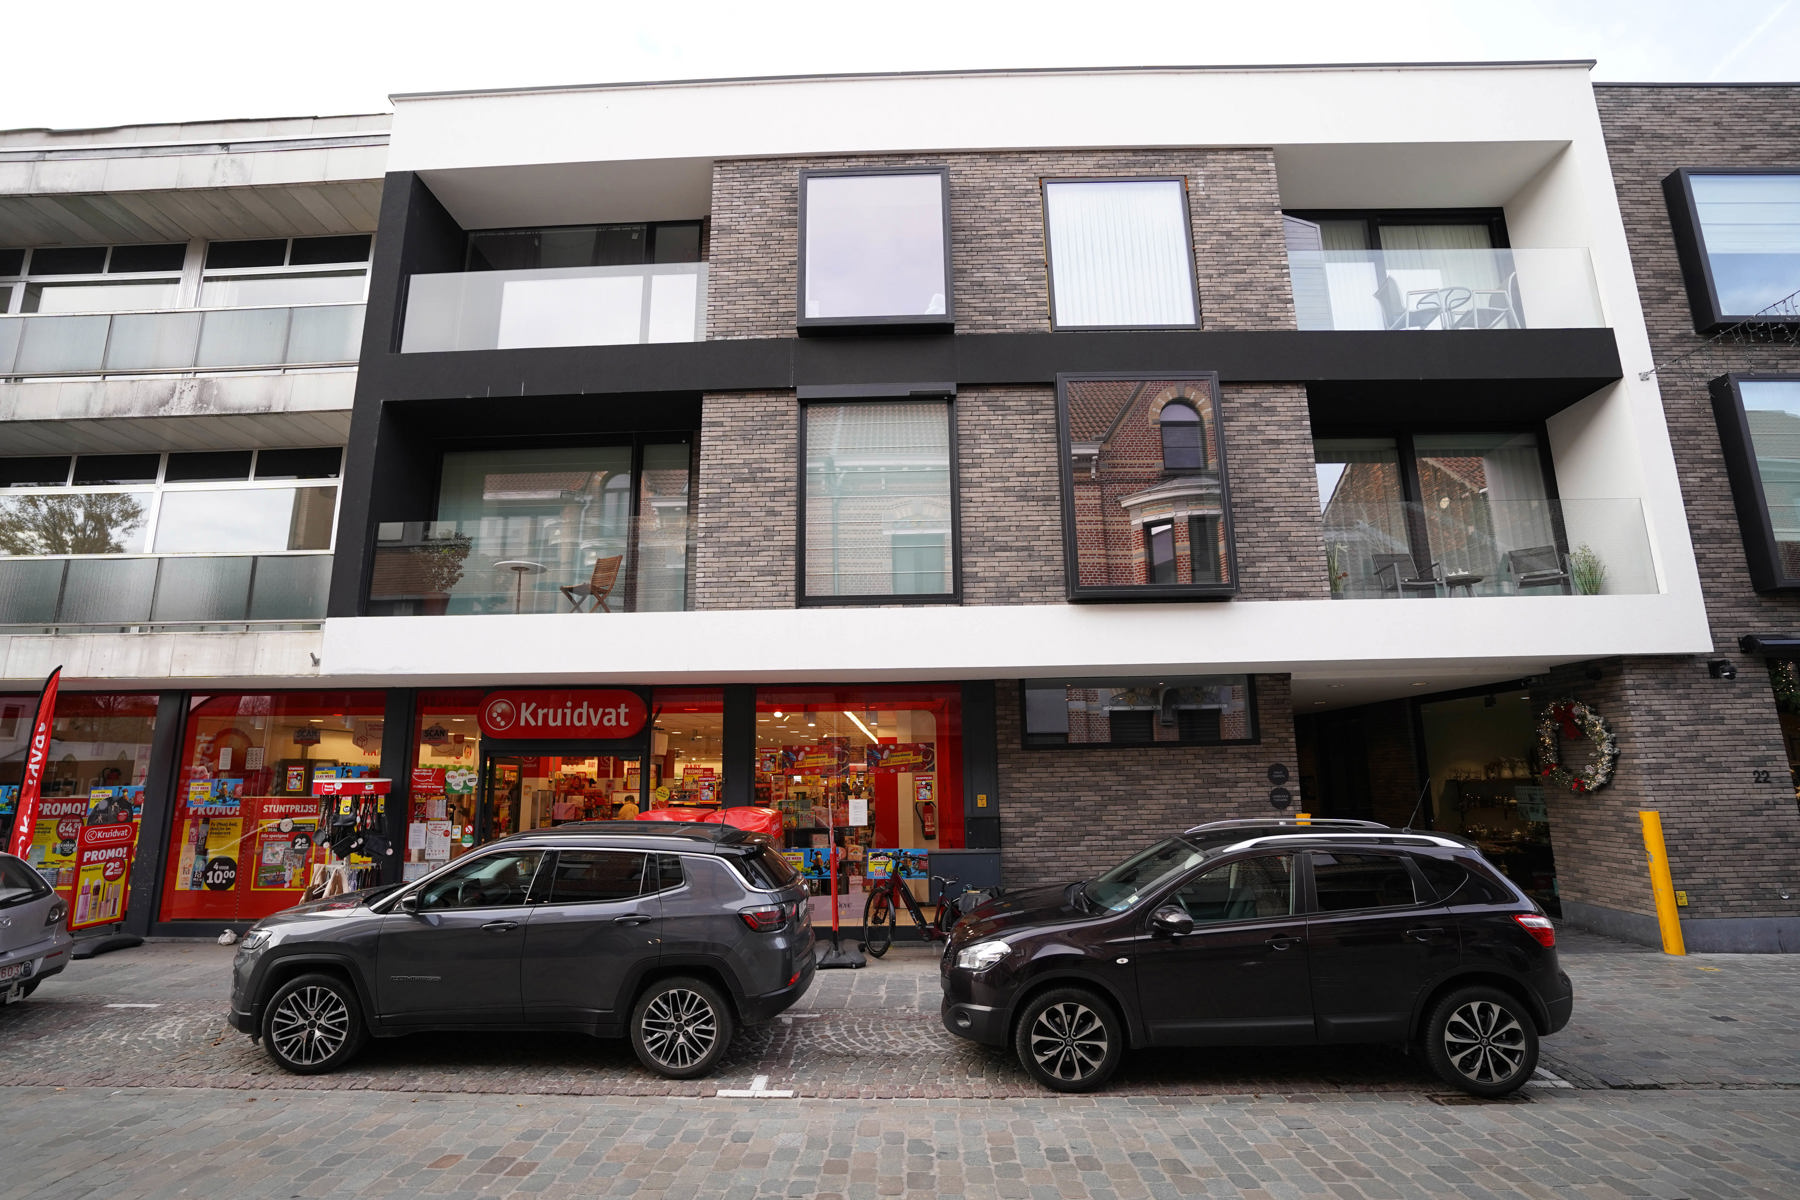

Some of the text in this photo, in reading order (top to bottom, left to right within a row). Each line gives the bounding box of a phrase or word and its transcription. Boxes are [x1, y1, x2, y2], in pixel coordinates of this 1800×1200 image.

[519, 701, 630, 727] Kruidvat
[424, 730, 446, 738] SCAN
[1753, 770, 1772, 783] 22
[38, 803, 86, 816] PROMO!
[263, 805, 317, 813] STUNTPRIJS!
[97, 829, 127, 839] Kruidvat
[83, 847, 127, 862] PROMO!
[105, 861, 120, 875] 2e
[213, 862, 219, 870] 4
[206, 871, 235, 884] 10.00
